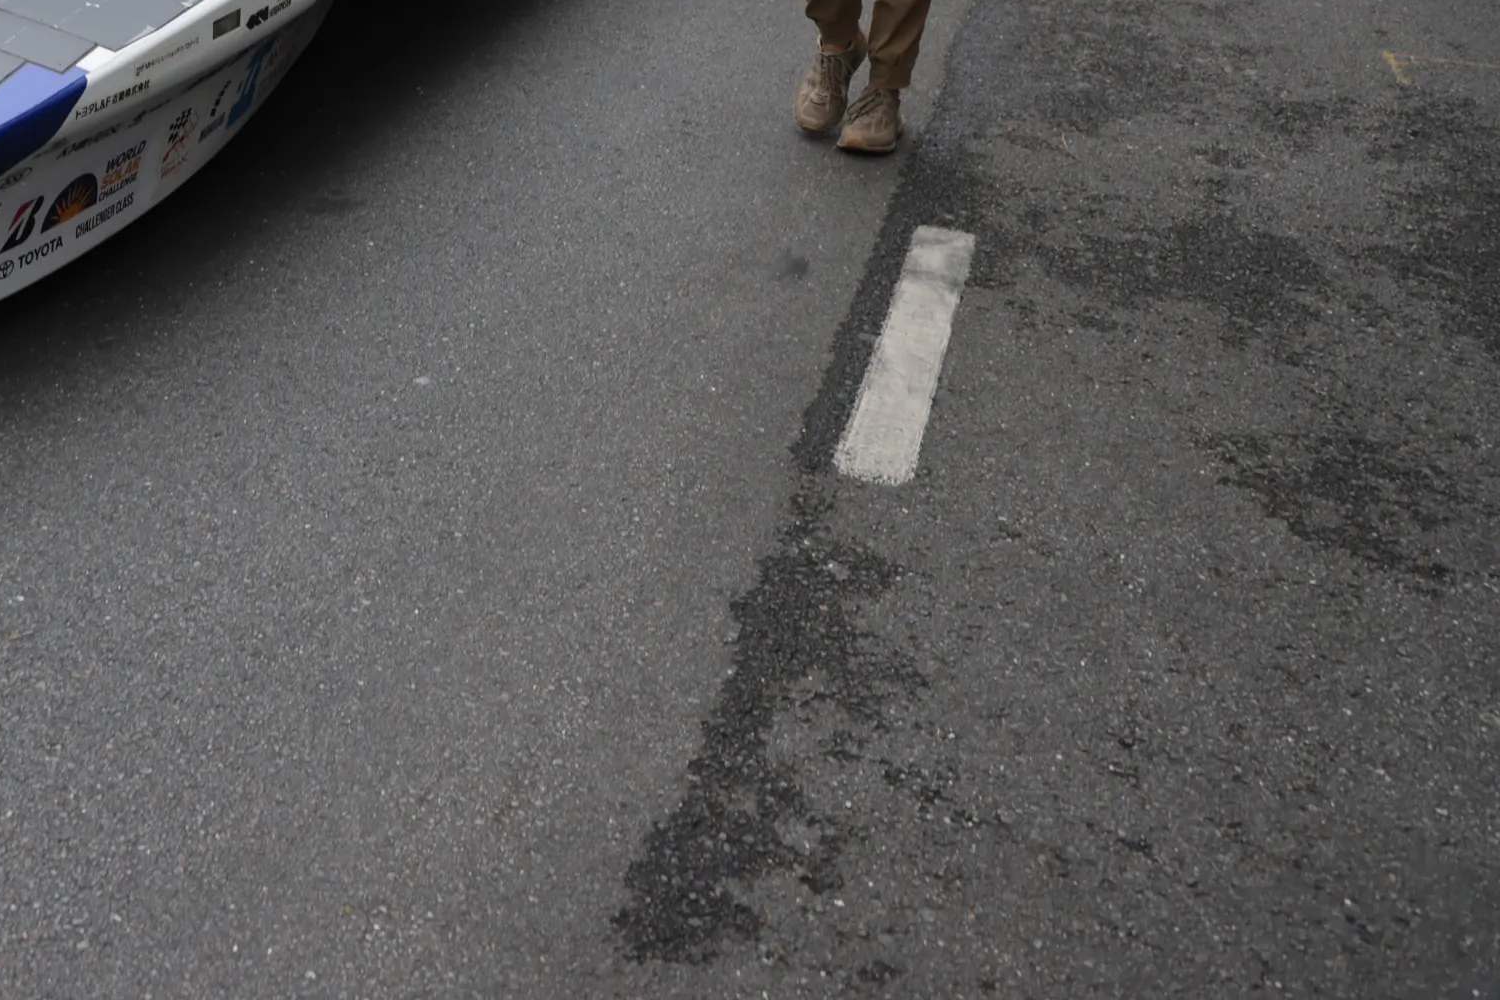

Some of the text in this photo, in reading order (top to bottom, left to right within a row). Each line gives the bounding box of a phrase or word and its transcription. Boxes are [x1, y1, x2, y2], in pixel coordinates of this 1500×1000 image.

[100, 156, 141, 190] SOLAR
[106, 140, 146, 173] WORLD
[99, 171, 138, 202] CHALLENGE
[75, 192, 134, 239] CHALLENGER CLASS
[17, 236, 64, 270] TOYOTA
